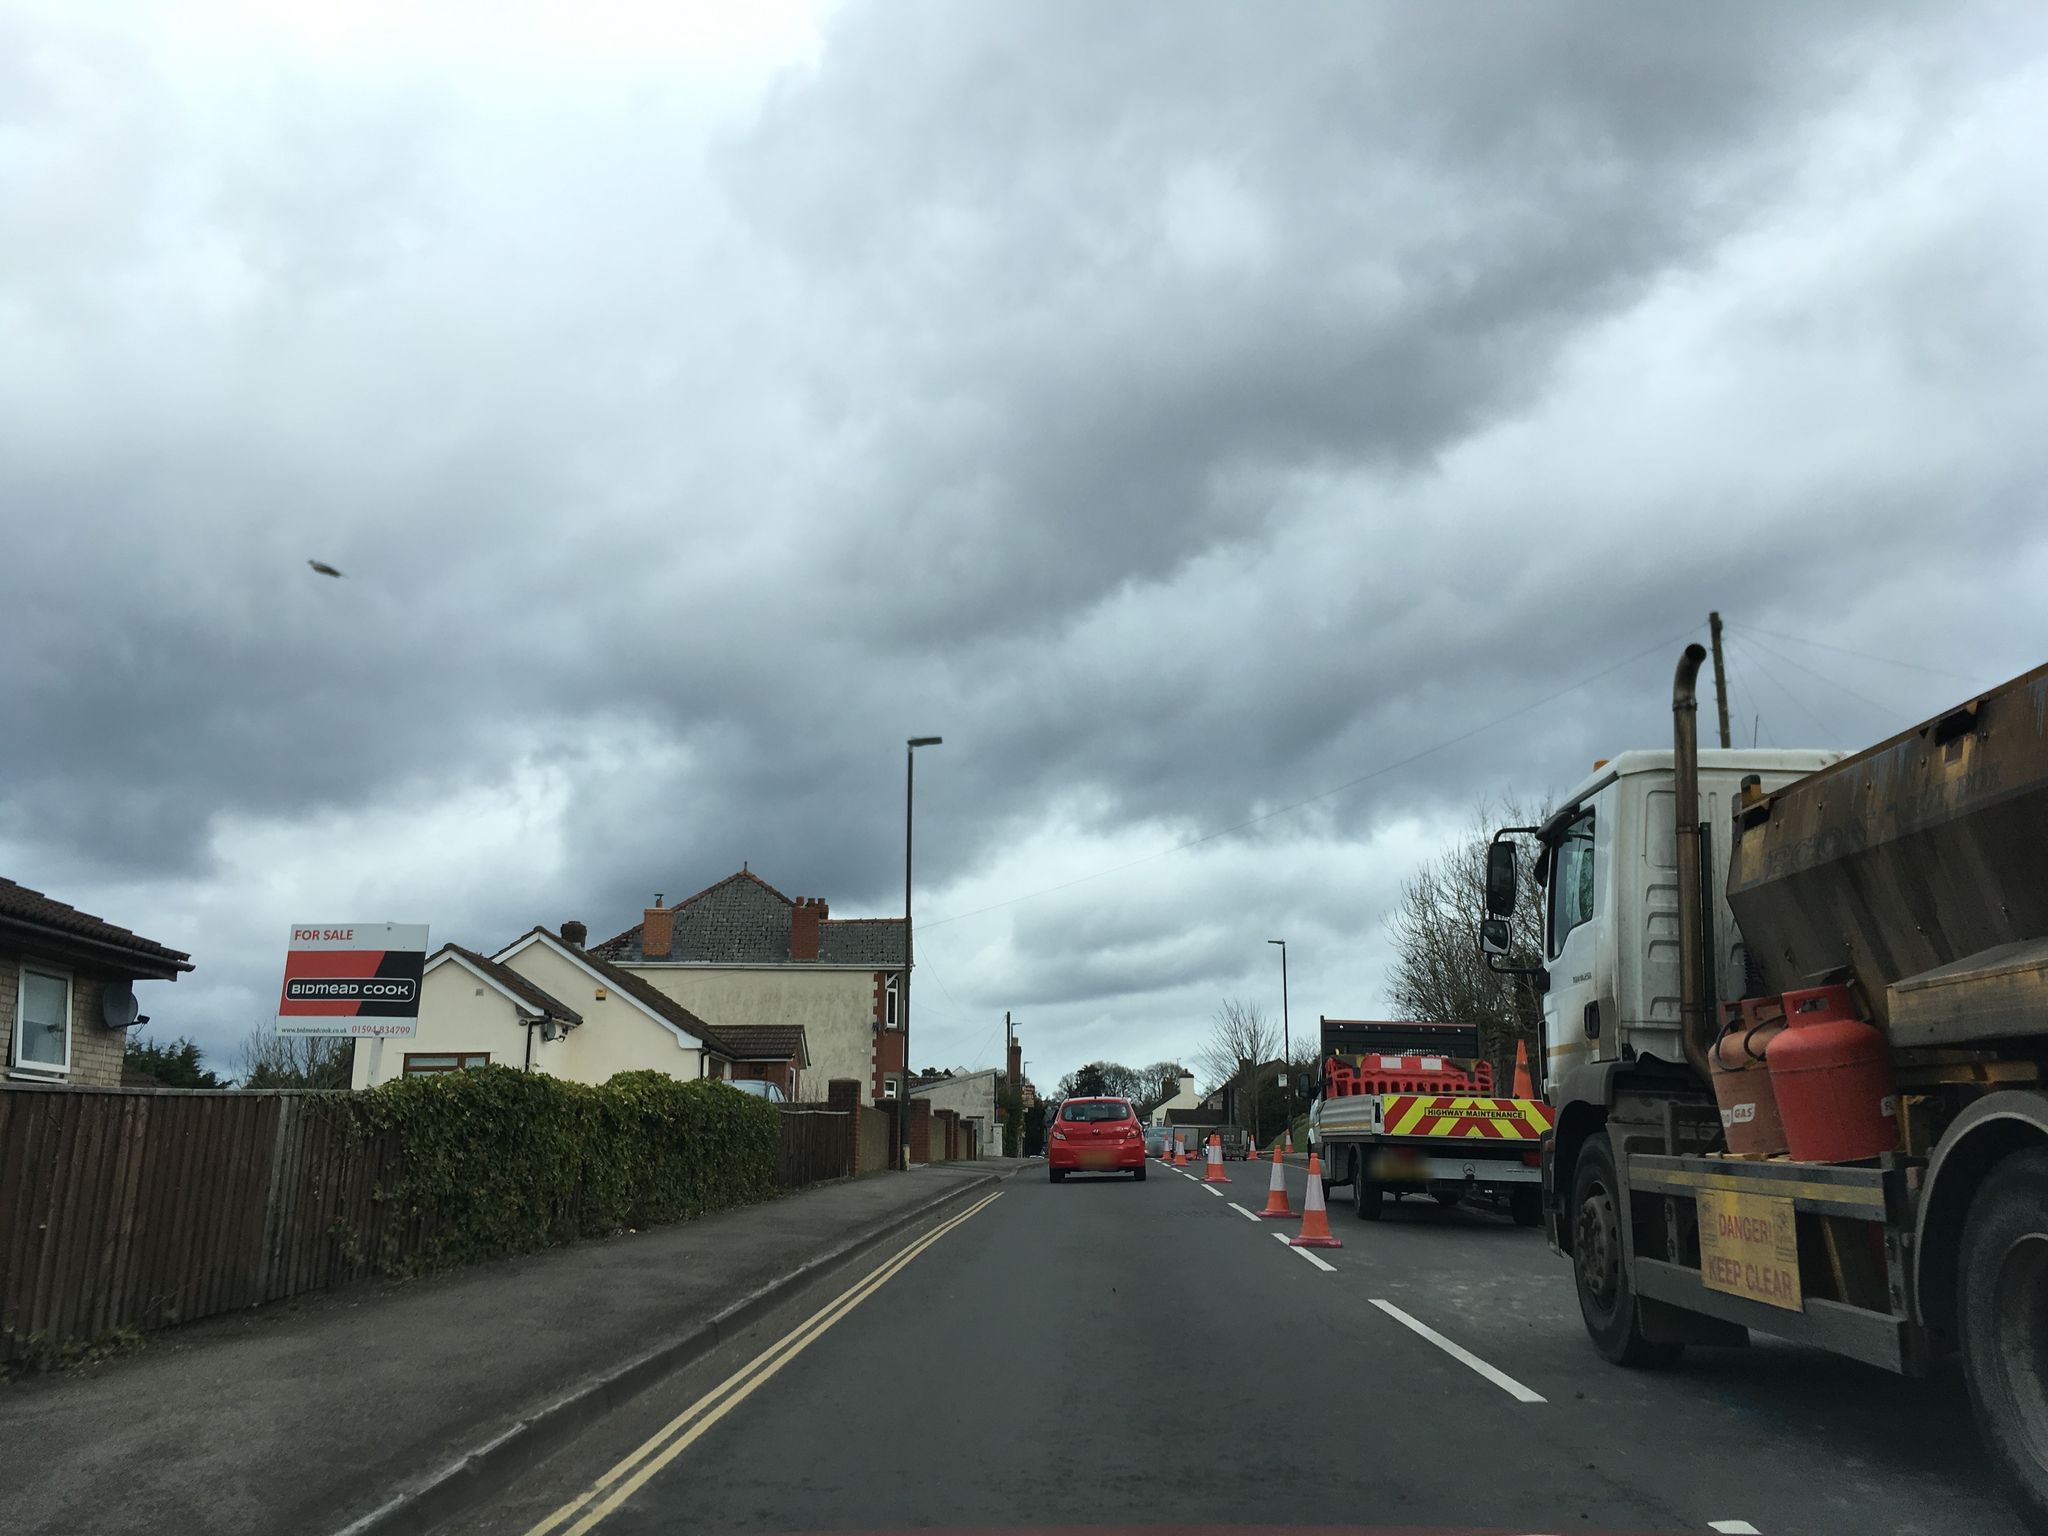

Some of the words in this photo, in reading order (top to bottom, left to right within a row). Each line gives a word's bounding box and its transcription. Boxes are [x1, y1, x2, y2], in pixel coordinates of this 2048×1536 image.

[294, 930, 320, 941] FOR
[323, 930, 354, 941] SALE
[363, 985, 408, 995] COOK
[281, 1026, 347, 1034] www.bidmeadcook.co.uk
[1427, 1109, 1464, 1118] HIGHWAY
[1466, 1110, 1523, 1119] MAINTENANCE
[1734, 1107, 1752, 1118] GAS
[1708, 1255, 1742, 1287] KEEP
[1745, 1263, 1793, 1300] CLEAR
